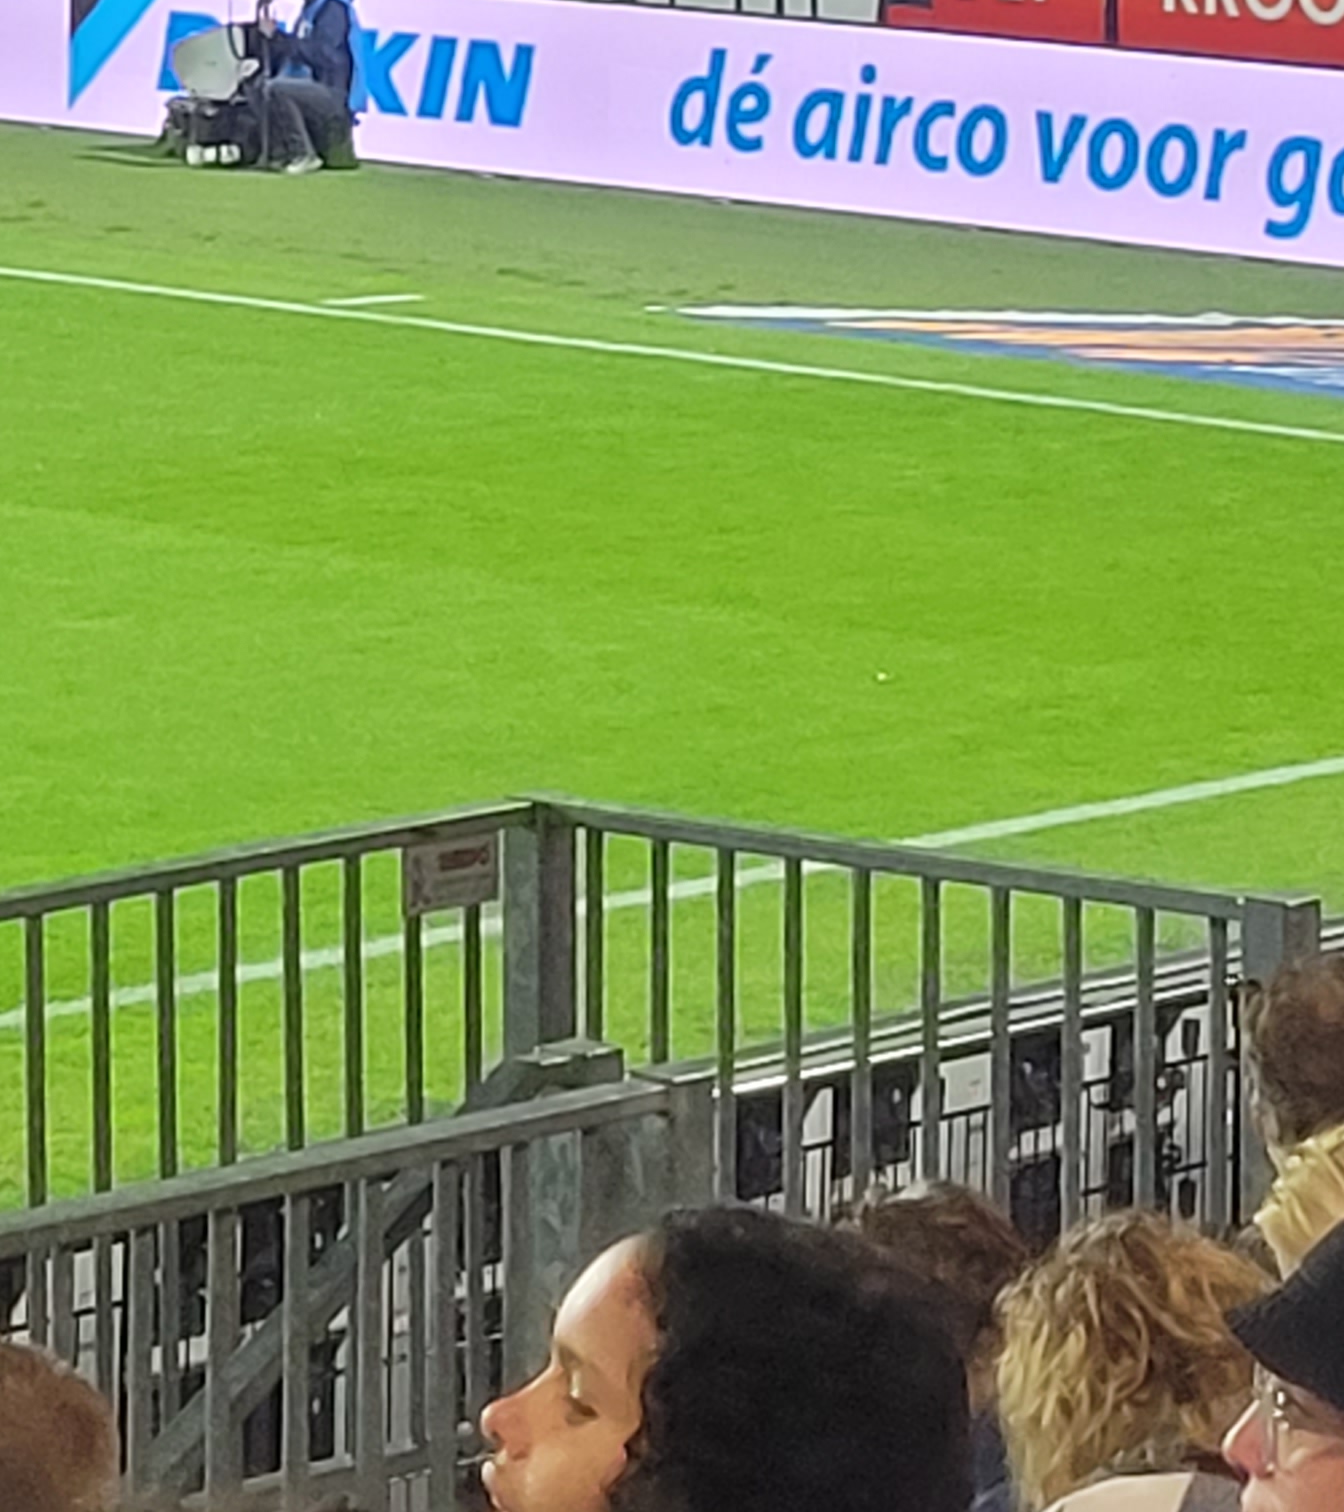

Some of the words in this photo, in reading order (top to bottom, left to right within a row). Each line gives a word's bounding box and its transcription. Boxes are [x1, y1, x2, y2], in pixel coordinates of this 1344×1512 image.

[669, 48, 773, 153] dé
[792, 64, 1008, 177] airco
[1035, 110, 1247, 201] voor
